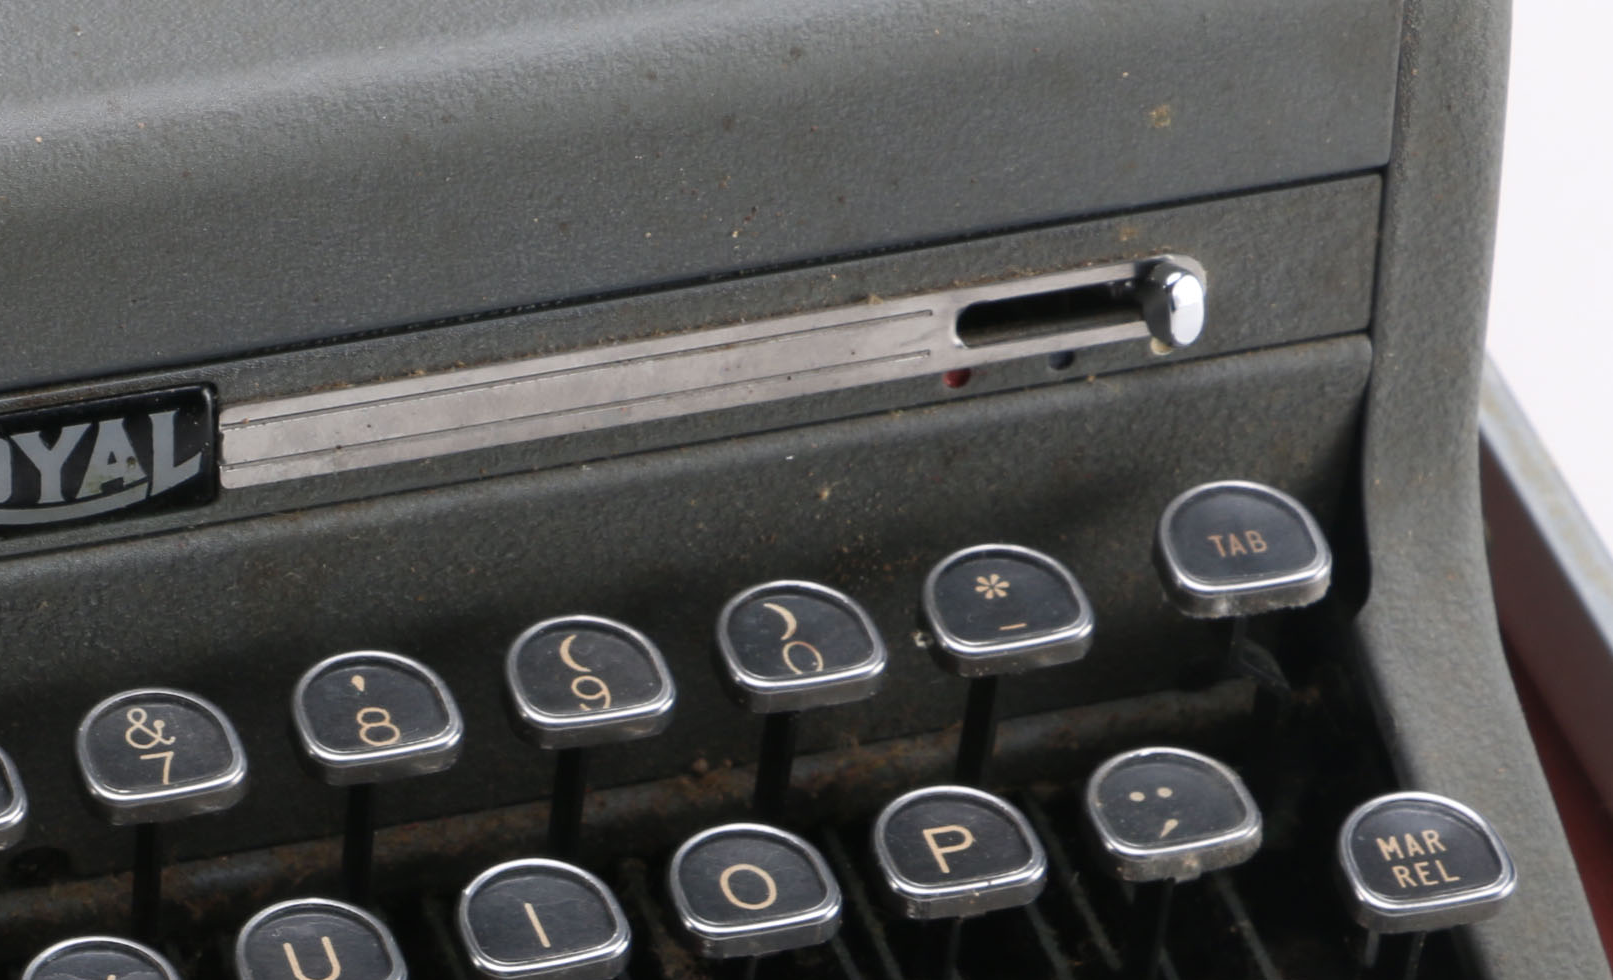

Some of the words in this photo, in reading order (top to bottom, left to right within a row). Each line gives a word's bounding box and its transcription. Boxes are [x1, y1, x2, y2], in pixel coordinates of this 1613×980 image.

[1207, 529, 1268, 558] TAB
[570, 674, 612, 710] 9
[124, 707, 176, 750] &
[355, 706, 402, 748] 8
[139, 750, 175, 786] 7
[922, 824, 975, 874] P
[1376, 829, 1446, 862] MAR
[718, 863, 778, 910] O
[1391, 859, 1460, 888] REL
[523, 902, 551, 948] I
